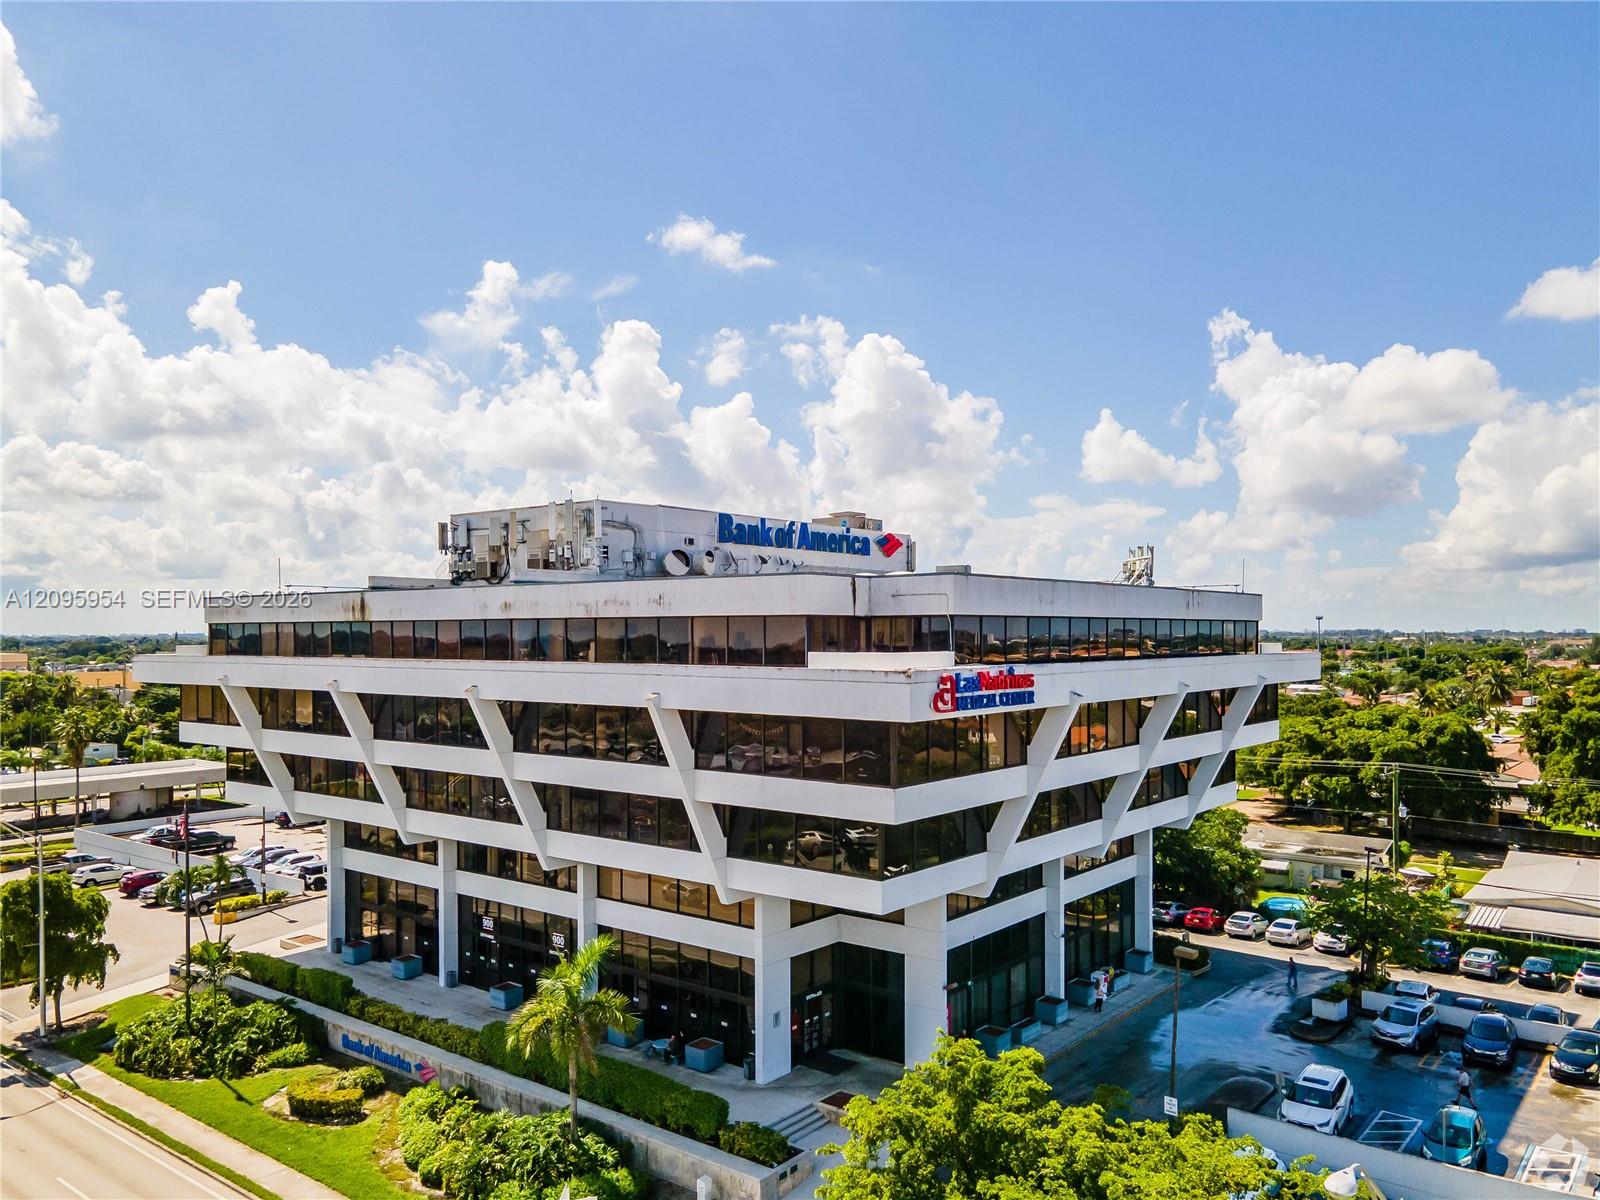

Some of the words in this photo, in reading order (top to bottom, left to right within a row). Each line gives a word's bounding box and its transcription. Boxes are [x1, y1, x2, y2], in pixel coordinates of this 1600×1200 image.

[718, 513, 773, 547] Bank
[772, 521, 796, 549] of
[797, 523, 871, 556] America
[482, 918, 494, 928] 900
[552, 935, 565, 946] 900
[341, 1033, 364, 1055] Bank
[374, 1045, 412, 1073] America
